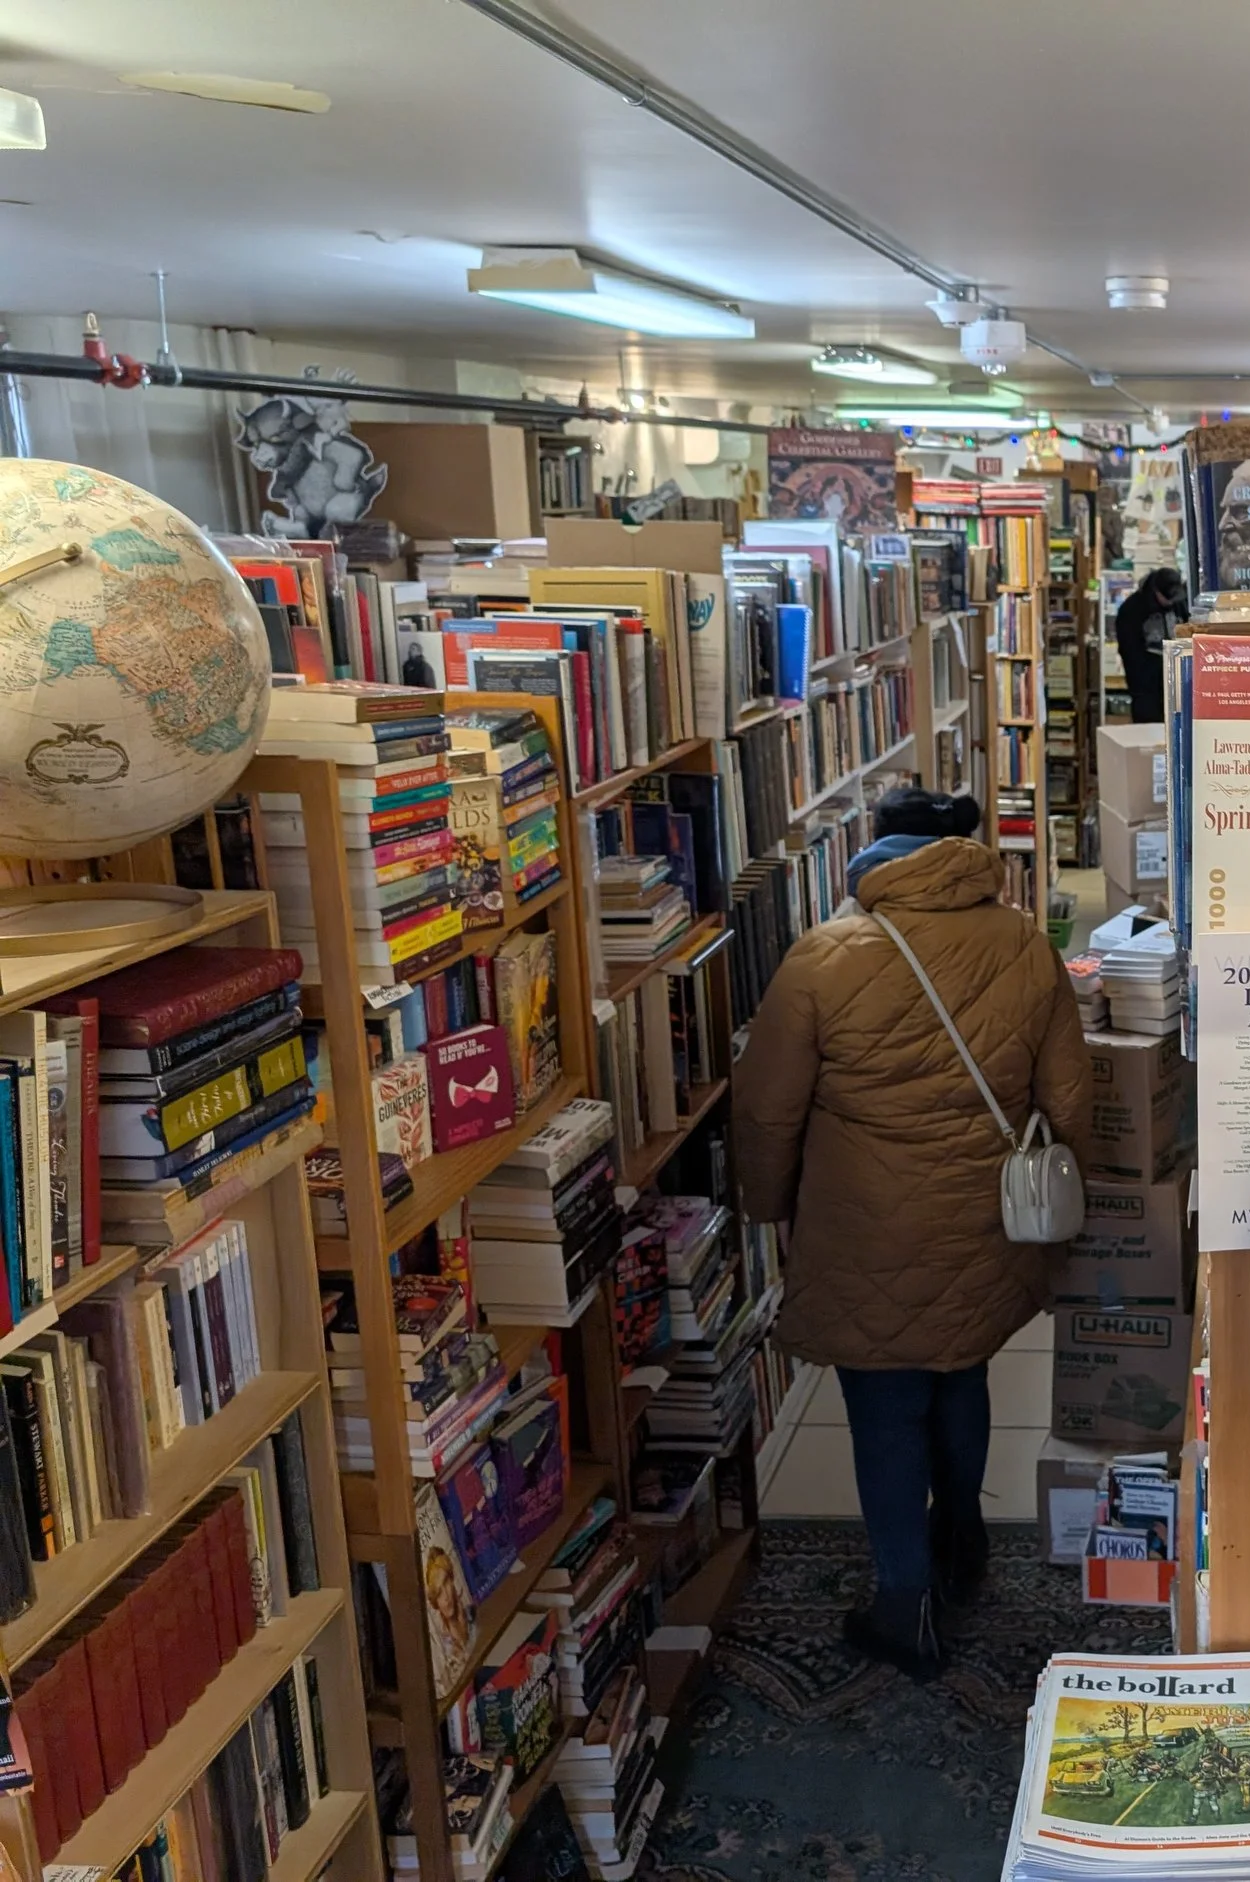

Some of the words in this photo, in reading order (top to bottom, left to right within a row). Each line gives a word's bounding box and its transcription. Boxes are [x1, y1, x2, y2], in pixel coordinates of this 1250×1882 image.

[980, 459, 1000, 474] EXIT
[452, 808, 490, 830] LDS
[1209, 869, 1226, 930] 1000
[378, 1083, 427, 1123] GUINEVERES
[1086, 1199, 1140, 1210] -HAUL
[1079, 1317, 1165, 1336] U-HAUL
[30, 1423, 44, 1469] STEWART
[37, 1472, 49, 1511] PARKER
[1098, 1539, 1146, 1560] CHORDS
[1062, 1673, 1112, 1691] the
[1118, 1676, 1236, 1697] bollard
